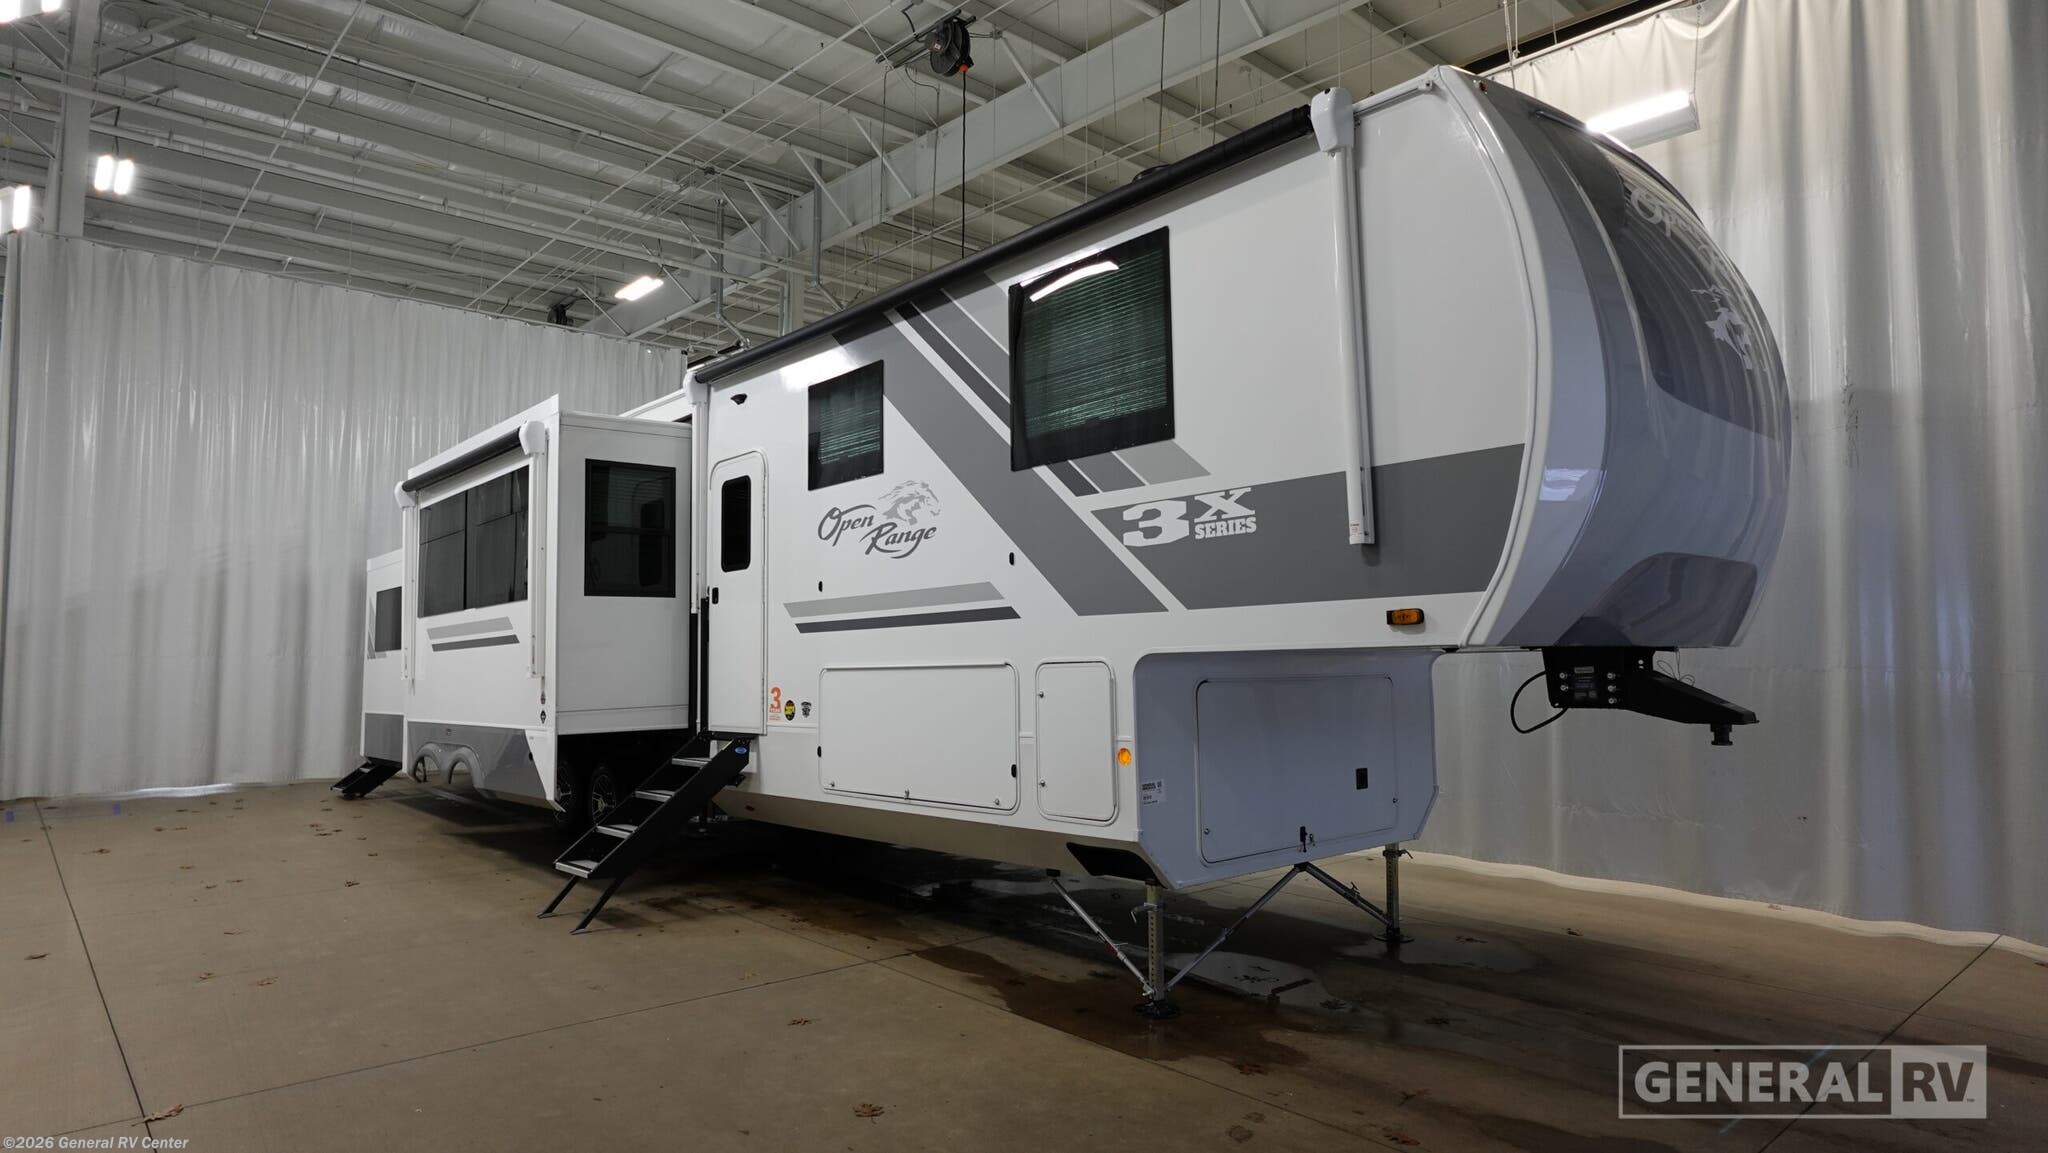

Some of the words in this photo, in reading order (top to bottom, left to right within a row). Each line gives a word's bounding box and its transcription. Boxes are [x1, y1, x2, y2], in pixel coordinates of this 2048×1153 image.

[817, 504, 877, 547] Open
[859, 521, 938, 560] Range
[1194, 516, 1257, 540] SERIES
[770, 686, 782, 709] 3
